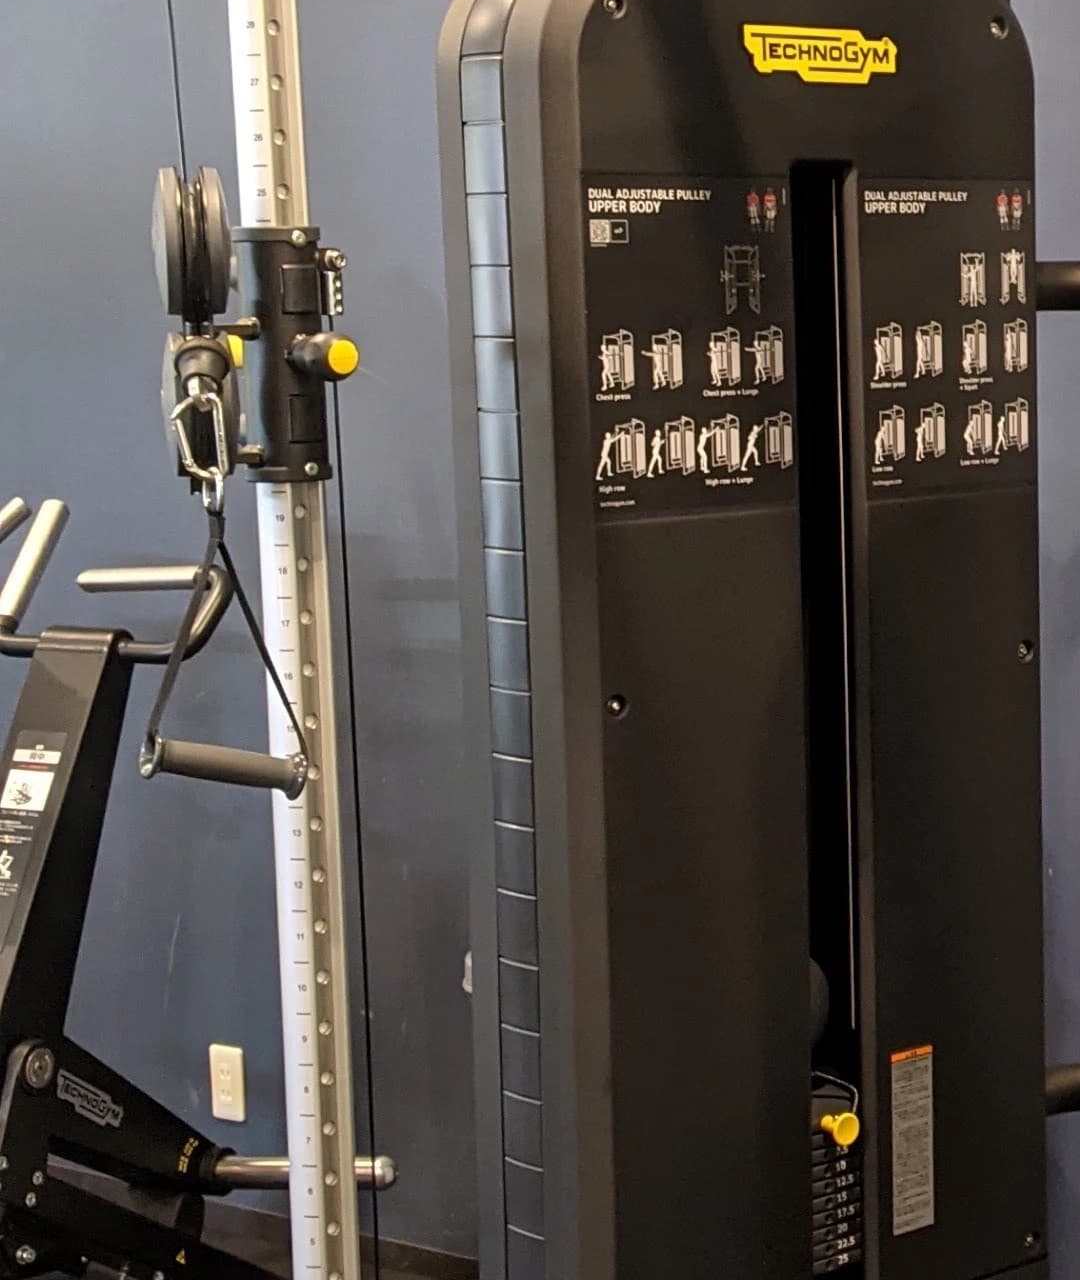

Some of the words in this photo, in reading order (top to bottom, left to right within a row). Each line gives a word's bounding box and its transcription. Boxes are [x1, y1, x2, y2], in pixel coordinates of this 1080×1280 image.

[750, 32, 890, 73] TECHNOGYM
[588, 188, 614, 199] DUAL
[616, 188, 675, 200] ADJUSTABLE
[676, 189, 711, 200] PULLEY
[864, 190, 886, 200] DUAL
[888, 191, 937, 201] ADJUSTABLE
[938, 191, 968, 202] PULLEY
[589, 200, 627, 213] UPPER
[629, 201, 661, 213] BODY
[864, 201, 897, 214] UPPER
[899, 202, 926, 214] BODY
[836, 1160, 846, 1171] 10
[836, 1174, 854, 1187] 12.5
[837, 1191, 847, 1202] 15
[837, 1205, 855, 1218] 17.5
[838, 1235, 856, 1249] 22.5
[838, 1253, 849, 1264] 25
